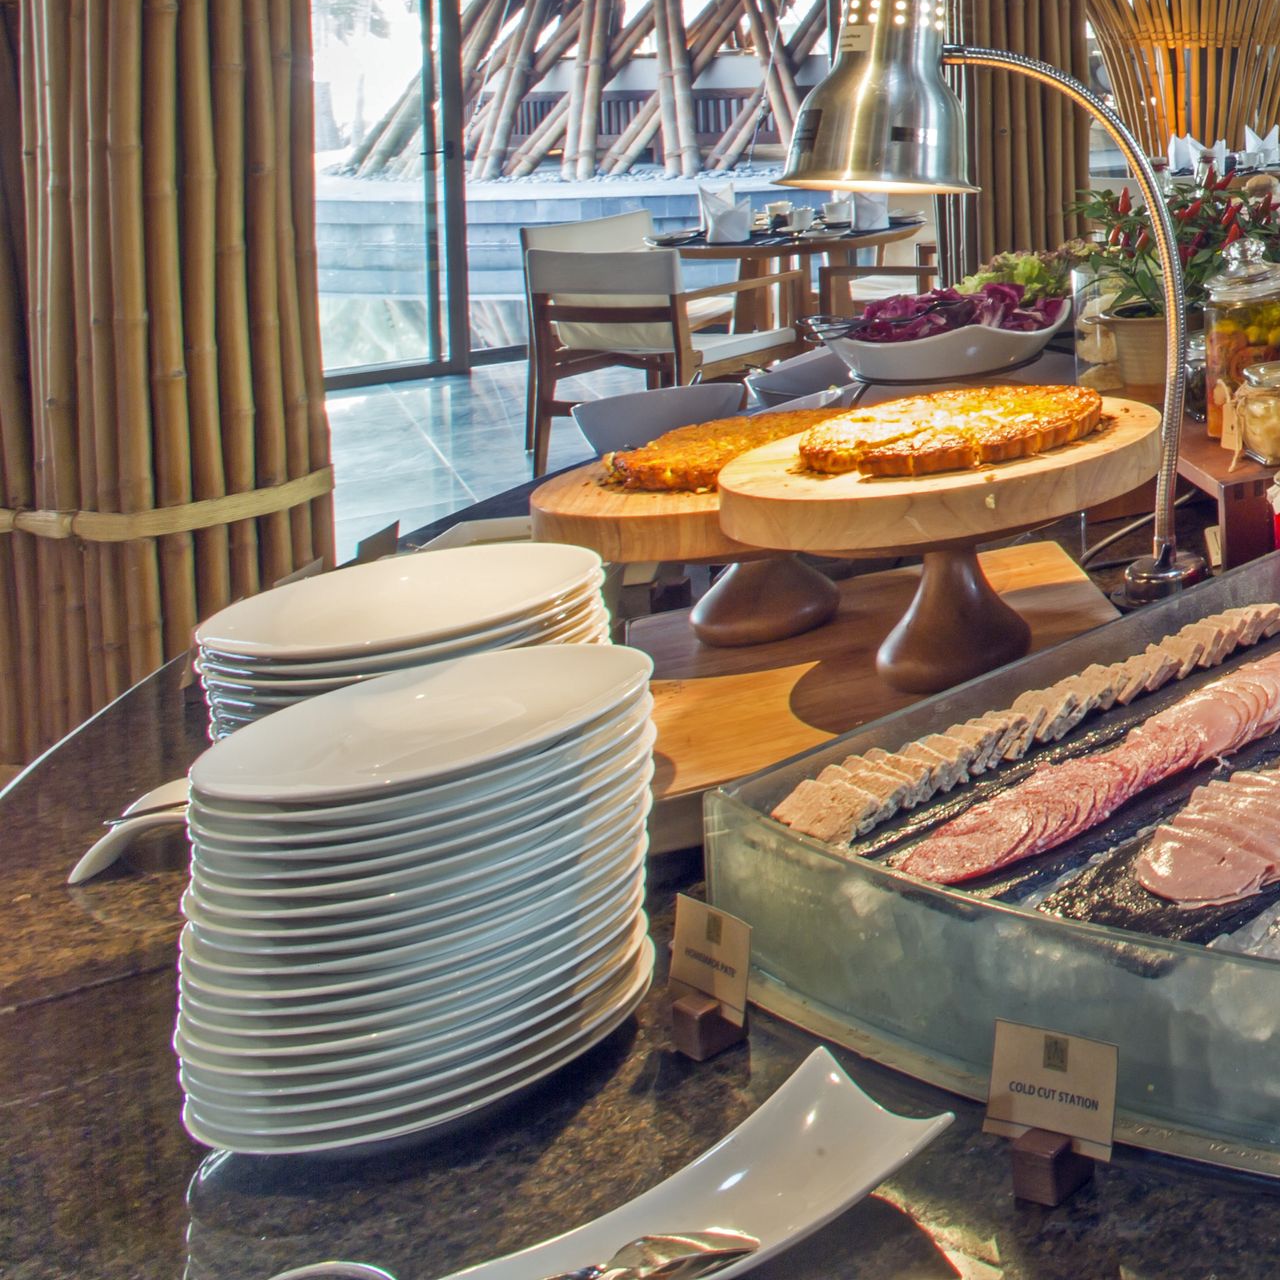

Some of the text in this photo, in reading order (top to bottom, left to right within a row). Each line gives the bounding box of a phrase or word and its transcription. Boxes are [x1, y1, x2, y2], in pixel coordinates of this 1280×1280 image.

[1008, 1080, 1099, 1111] COLD CUT STATION
